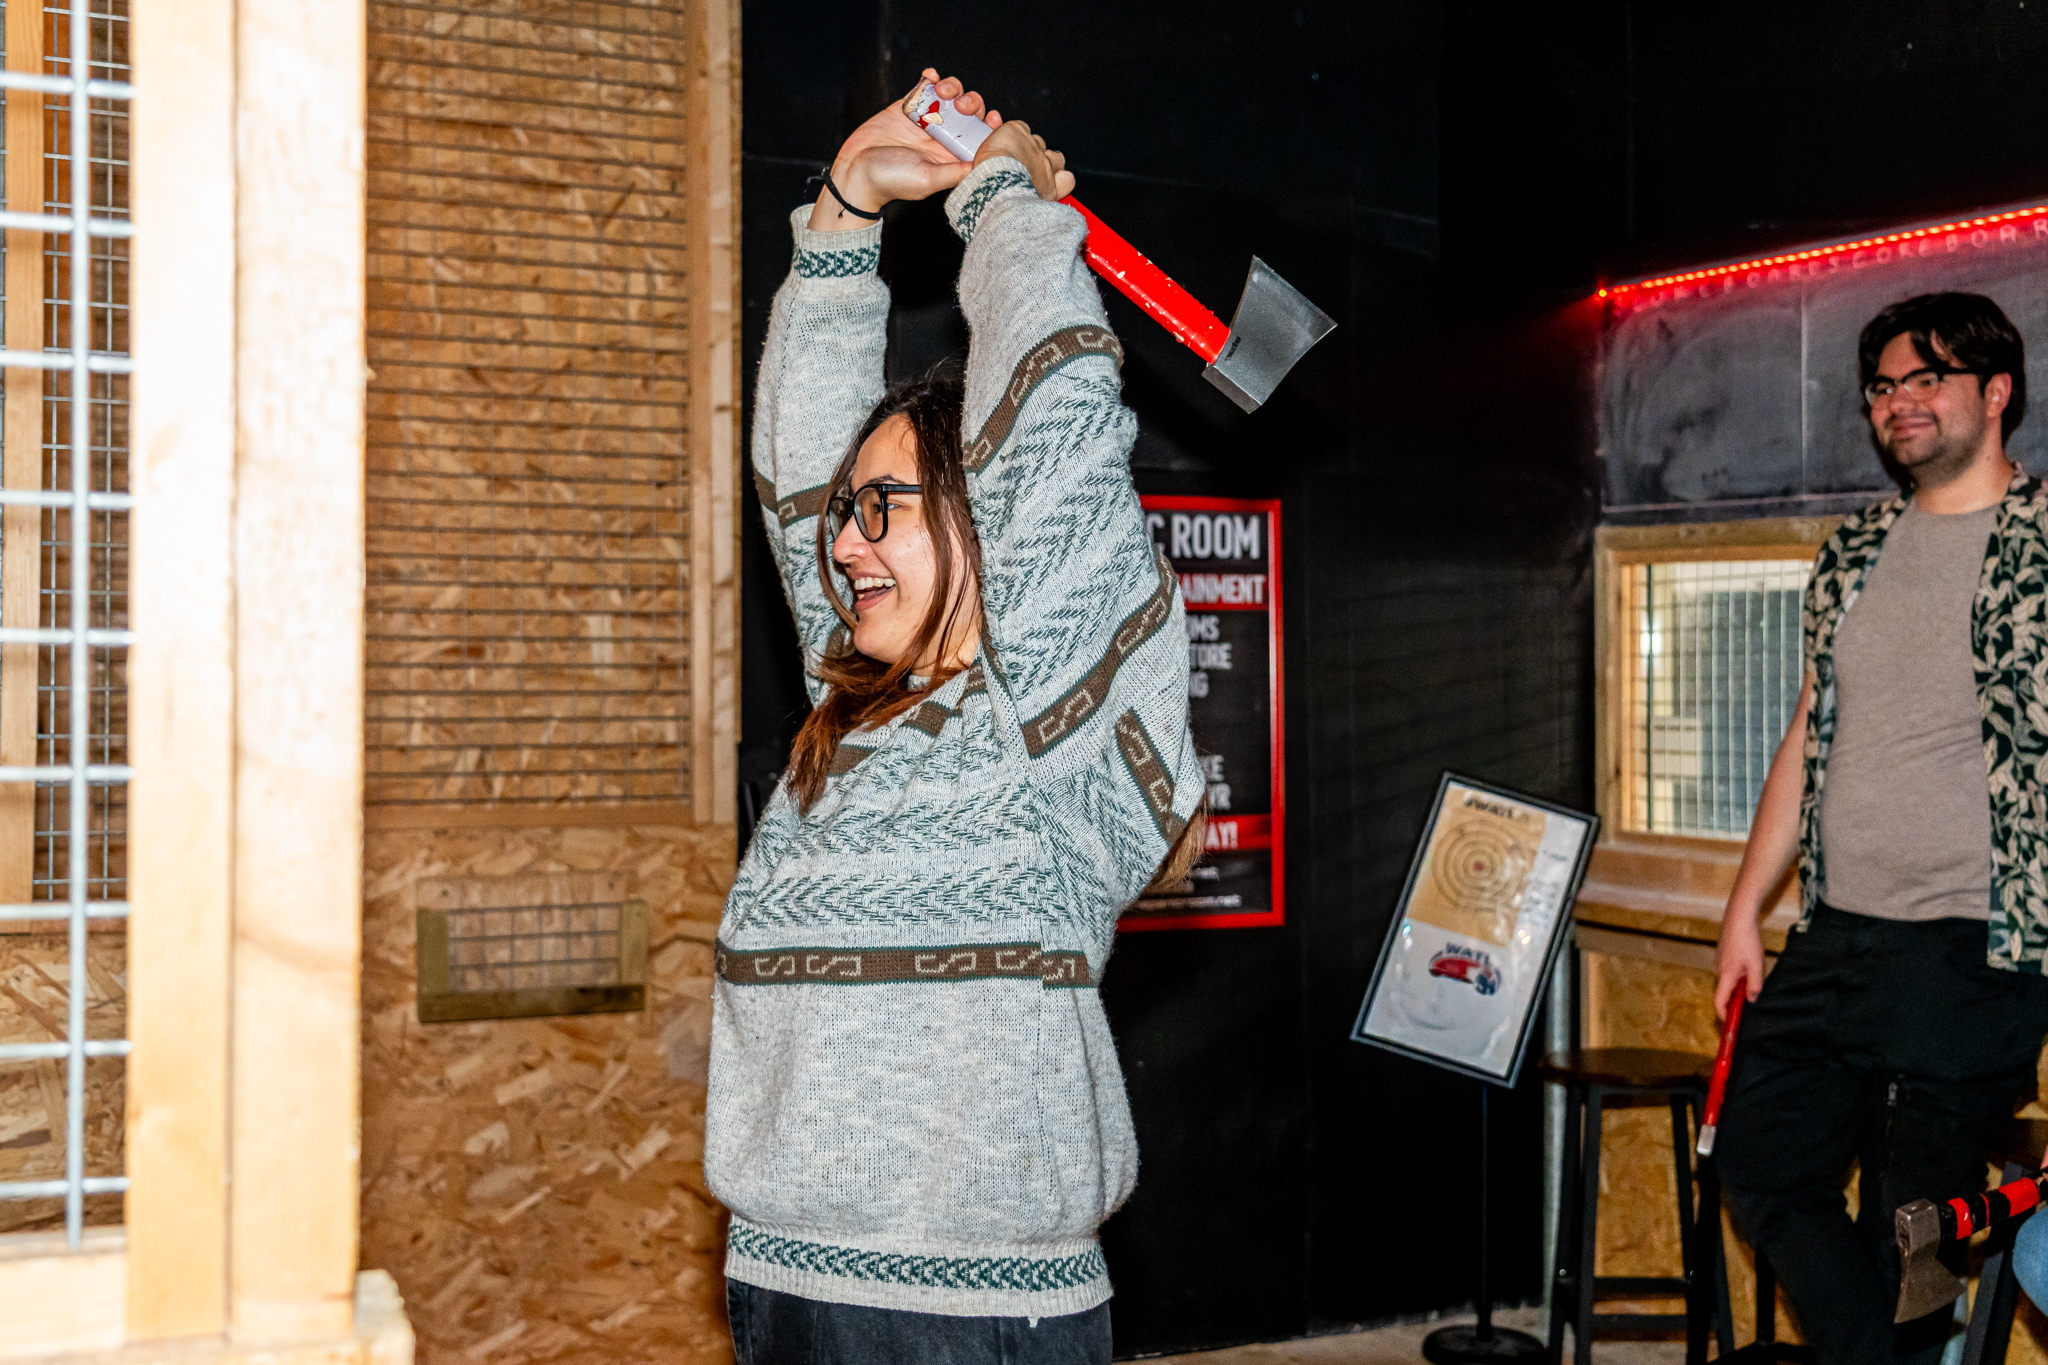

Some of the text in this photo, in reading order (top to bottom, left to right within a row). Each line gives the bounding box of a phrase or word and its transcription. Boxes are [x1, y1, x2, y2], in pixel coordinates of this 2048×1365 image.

[1171, 513, 1260, 560] ROOM
[1178, 573, 1267, 604] AINMENT
[1205, 820, 1239, 851] AY!
[1446, 941, 1490, 966] WATL
